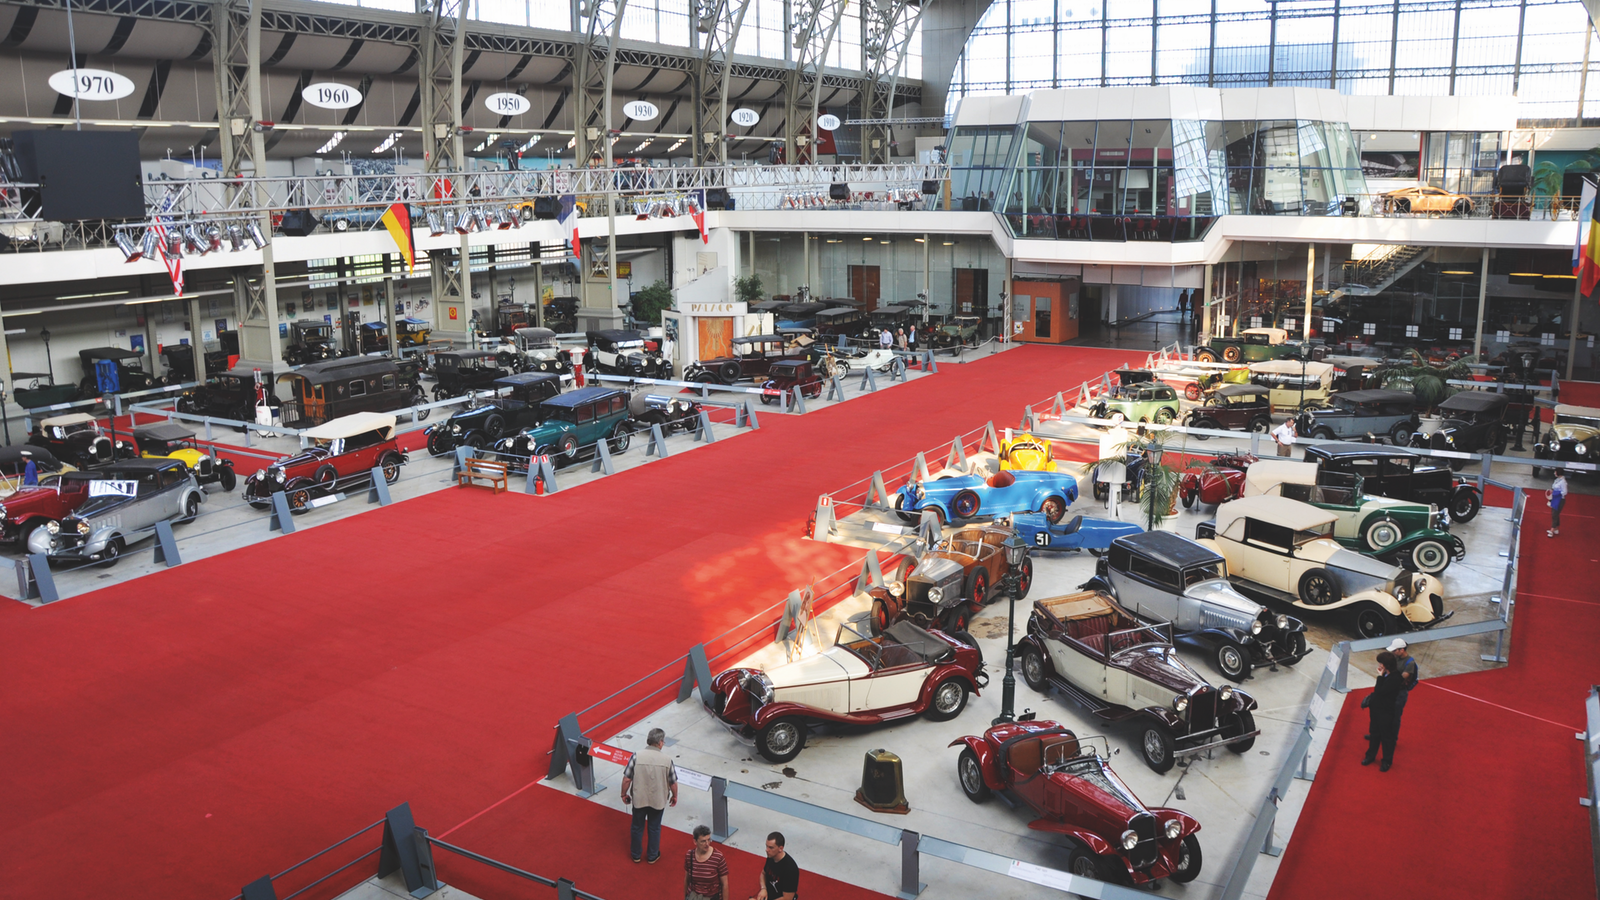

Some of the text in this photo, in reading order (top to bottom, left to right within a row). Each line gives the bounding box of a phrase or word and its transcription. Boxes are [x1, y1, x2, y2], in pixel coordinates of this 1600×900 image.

[72, 75, 114, 95] 1970
[318, 88, 349, 103] 1960
[497, 97, 520, 111] 1950
[634, 105, 653, 117] 1930
[738, 112, 753, 123] 1920
[1036, 533, 1049, 546] 31
